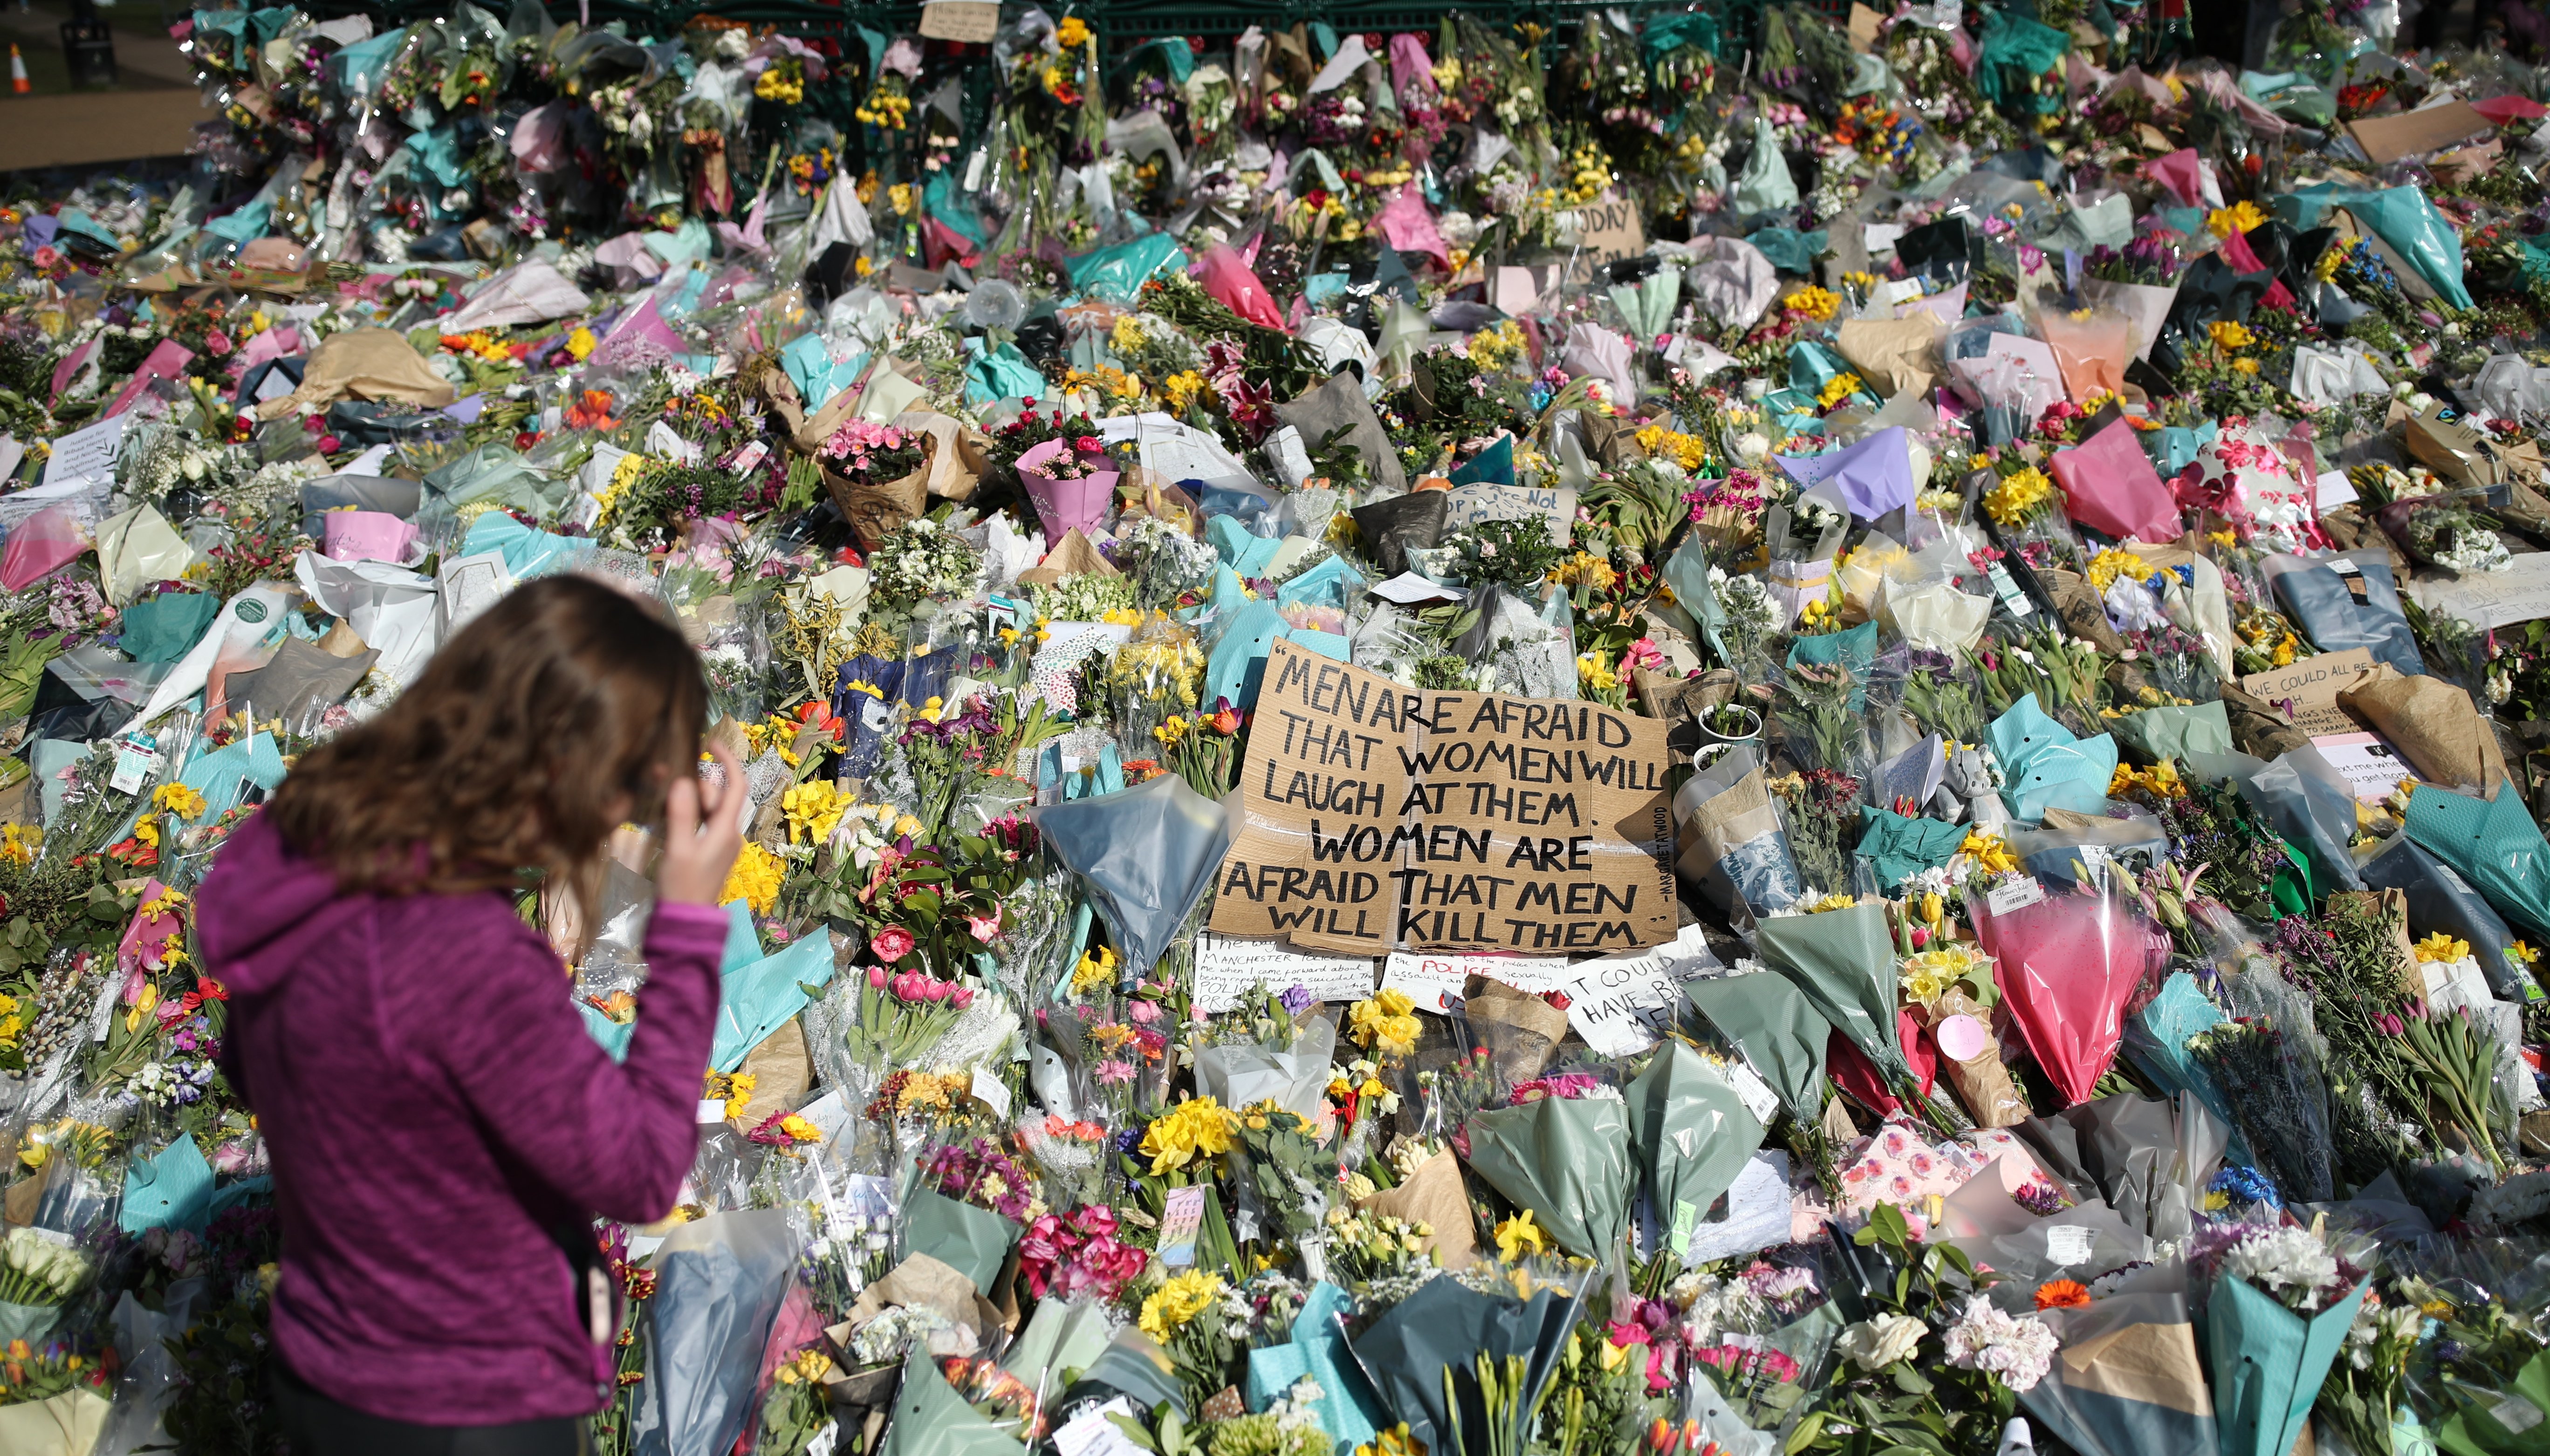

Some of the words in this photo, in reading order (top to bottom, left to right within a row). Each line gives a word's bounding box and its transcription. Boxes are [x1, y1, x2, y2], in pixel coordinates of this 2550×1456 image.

[1579, 203, 1630, 232] ODAY
[1527, 489, 1557, 510] Not
[992, 596, 1011, 605] WAITROSE
[2250, 681, 2274, 696] WE
[2281, 670, 2326, 691] COULD
[2331, 664, 2350, 676] ALL
[2354, 663, 2368, 672] BE
[1371, 694, 1465, 735] ARE
[1468, 697, 1631, 749] AFRAID
[2294, 715, 2350, 726] HANGE!!!
[2321, 723, 2346, 732] SARAH
[1280, 710, 1382, 771] THAT
[1397, 741, 1572, 784] WOMEN
[1577, 749, 1665, 791] WILL
[2374, 760, 2408, 769] when
[2362, 773, 2381, 784] get
[1264, 759, 1385, 818] LAUGH
[1398, 782, 1460, 816] AT
[1466, 781, 1599, 827] THEM.
[1311, 819, 1492, 862] WOMEN
[1505, 834, 1594, 872] ARE
[1223, 861, 1379, 903] AFRAID
[1389, 868, 1516, 911] THAT
[1515, 881, 1638, 915] MEN
[1268, 905, 1381, 939] WILL
[1398, 907, 1499, 942] KILL
[1200, 930, 1244, 951] The
[1252, 939, 1278, 952] way
[1203, 953, 1292, 965] MANCHESTER
[1302, 951, 1338, 962] POLICE
[1480, 956, 1496, 965] the
[1200, 974, 1227, 986] being
[1230, 975, 1257, 986] raped
[1359, 971, 1375, 980] The
[1220, 966, 1243, 974] when
[1250, 966, 1254, 975] I
[1284, 965, 1326, 977] forward
[1331, 963, 1364, 971] about
[1391, 970, 1441, 981] assault
[1394, 957, 1411, 966] the
[1422, 960, 1492, 978] POLICE
[1504, 971, 1553, 986] sexually
[1600, 957, 1676, 988] COULD
[1200, 982, 1248, 994] POLIC
[1582, 991, 1648, 1024] HAVE
[1147, 1025, 1167, 1035] FLOWER
